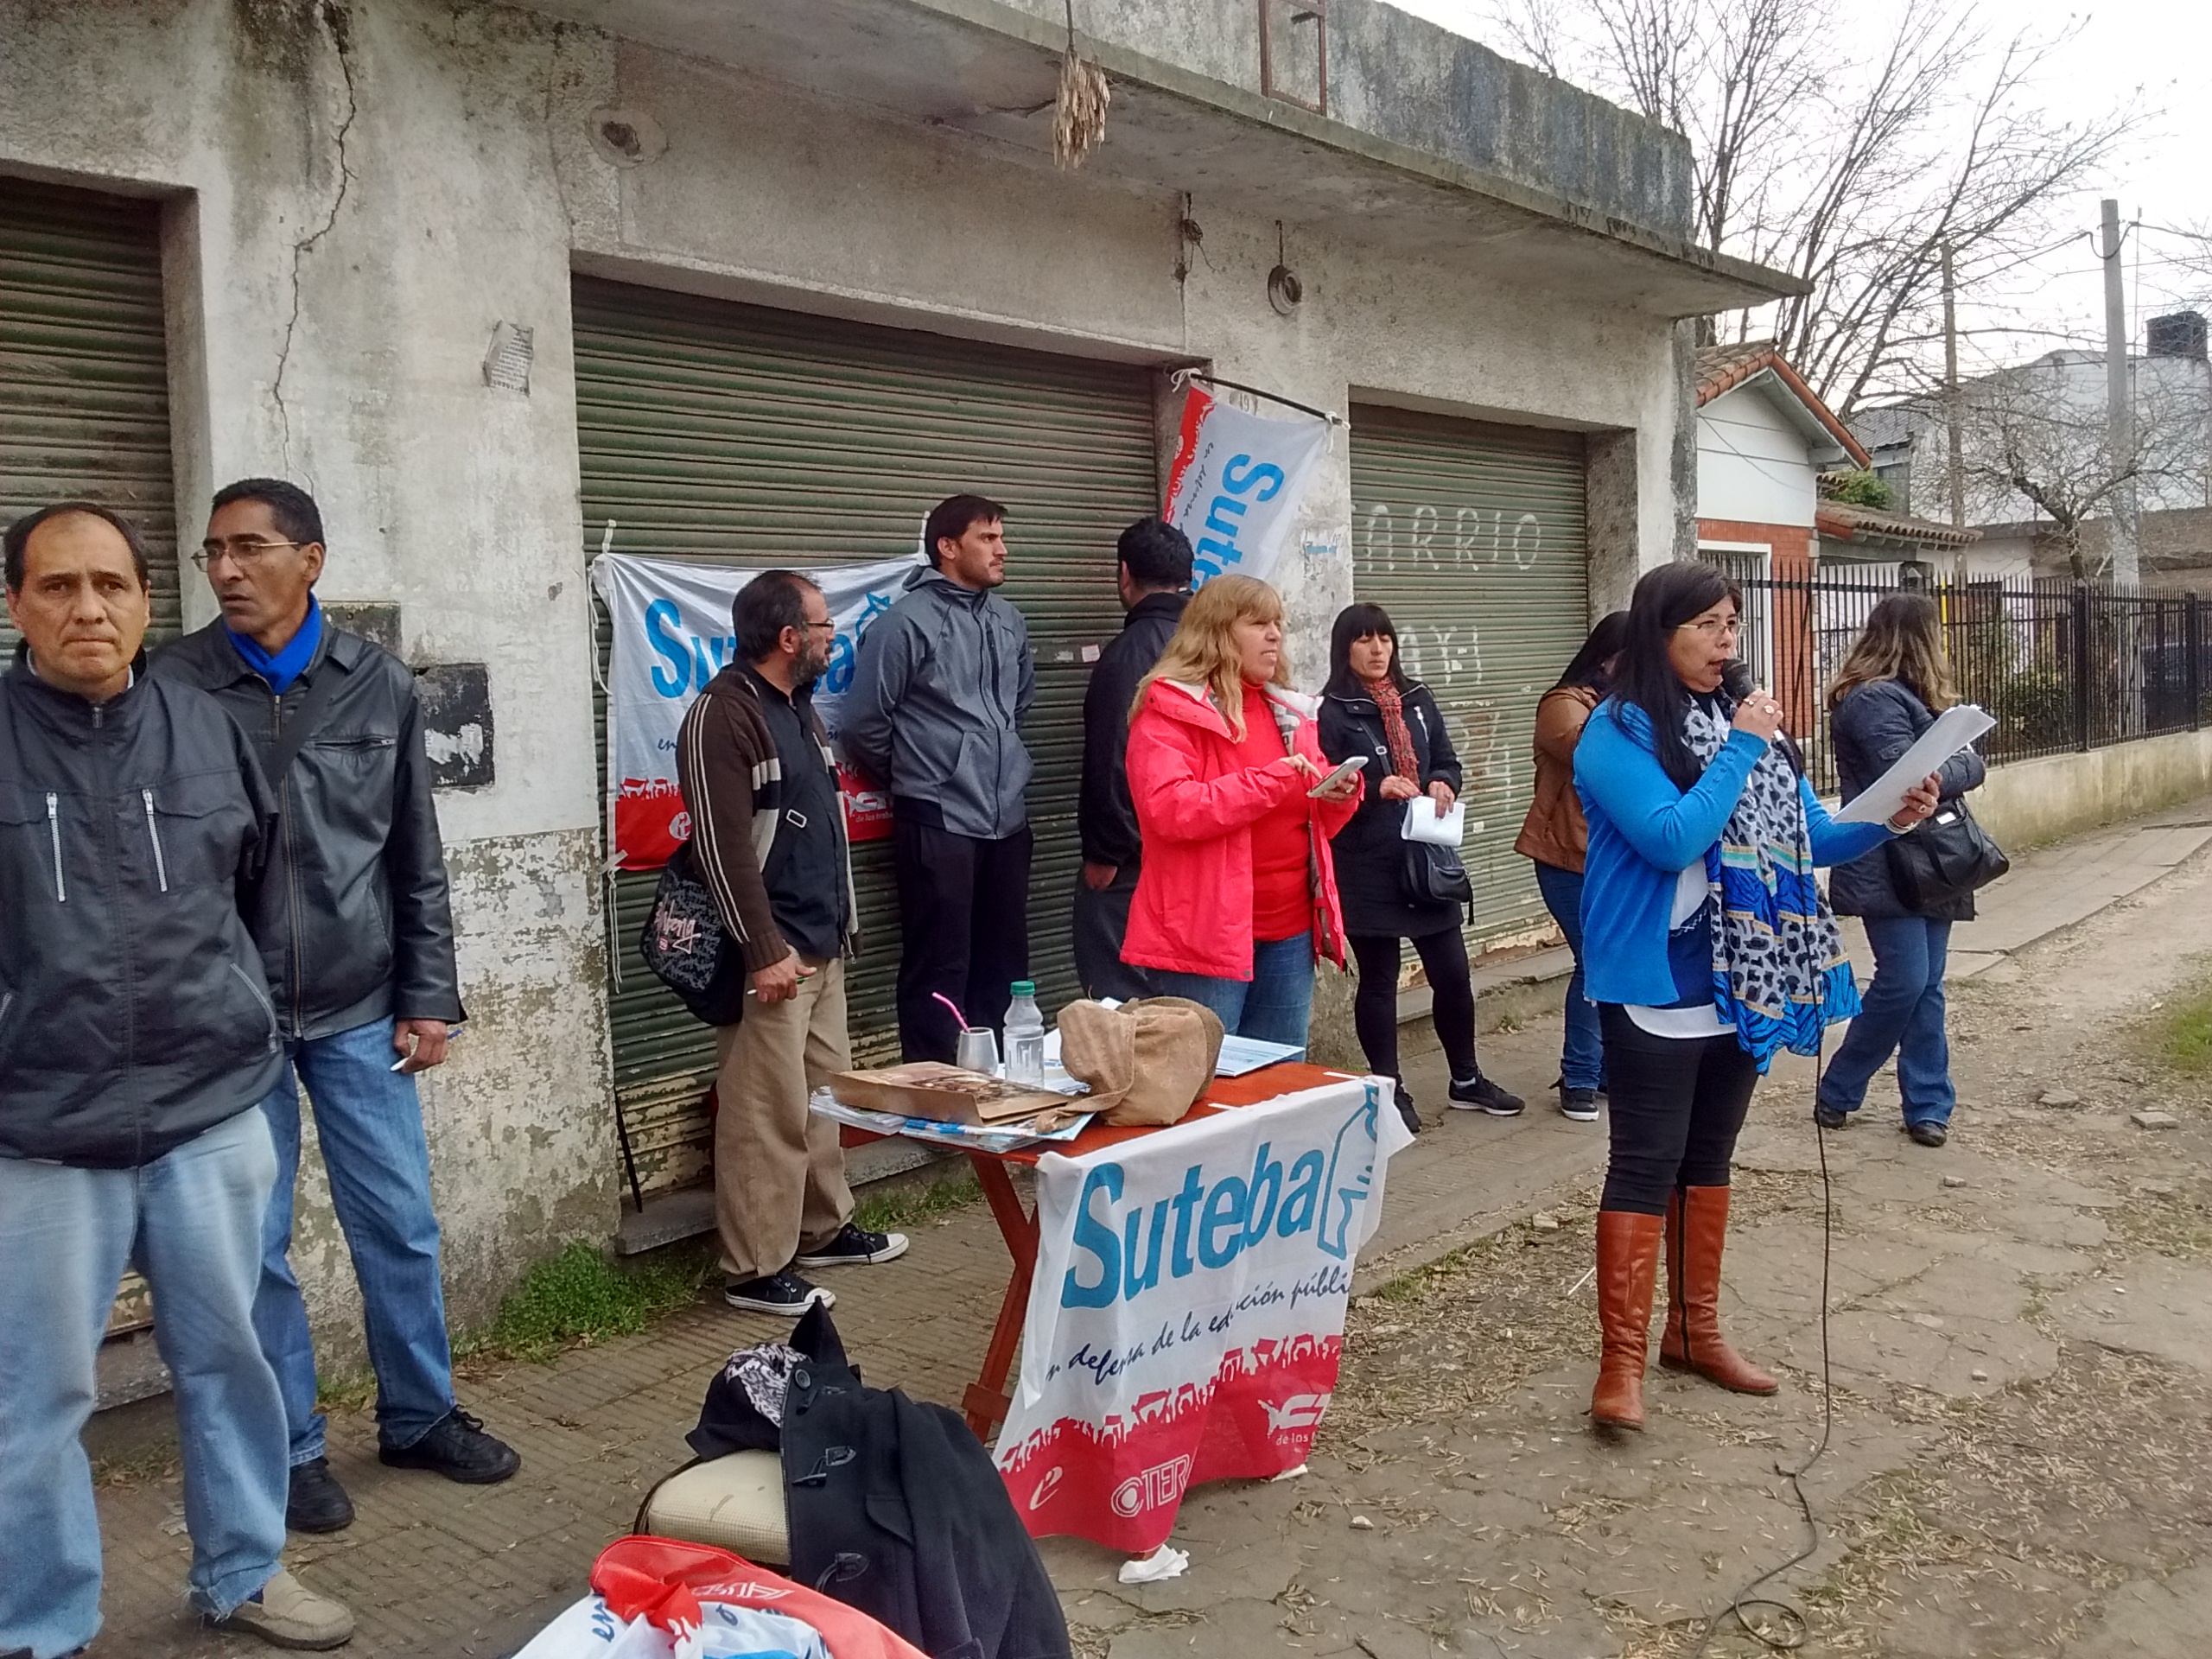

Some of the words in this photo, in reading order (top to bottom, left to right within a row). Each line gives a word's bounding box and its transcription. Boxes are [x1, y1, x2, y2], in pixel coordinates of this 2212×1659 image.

[1191, 454, 1285, 591] Sute
[1351, 505, 1541, 572] ARRIO
[1060, 1141, 1325, 1308] Suteba
[1151, 1320, 1175, 1356] de
[1180, 1311, 1203, 1343] la
[1290, 1265, 1350, 1310] públi
[1276, 1434, 1288, 1446] de
